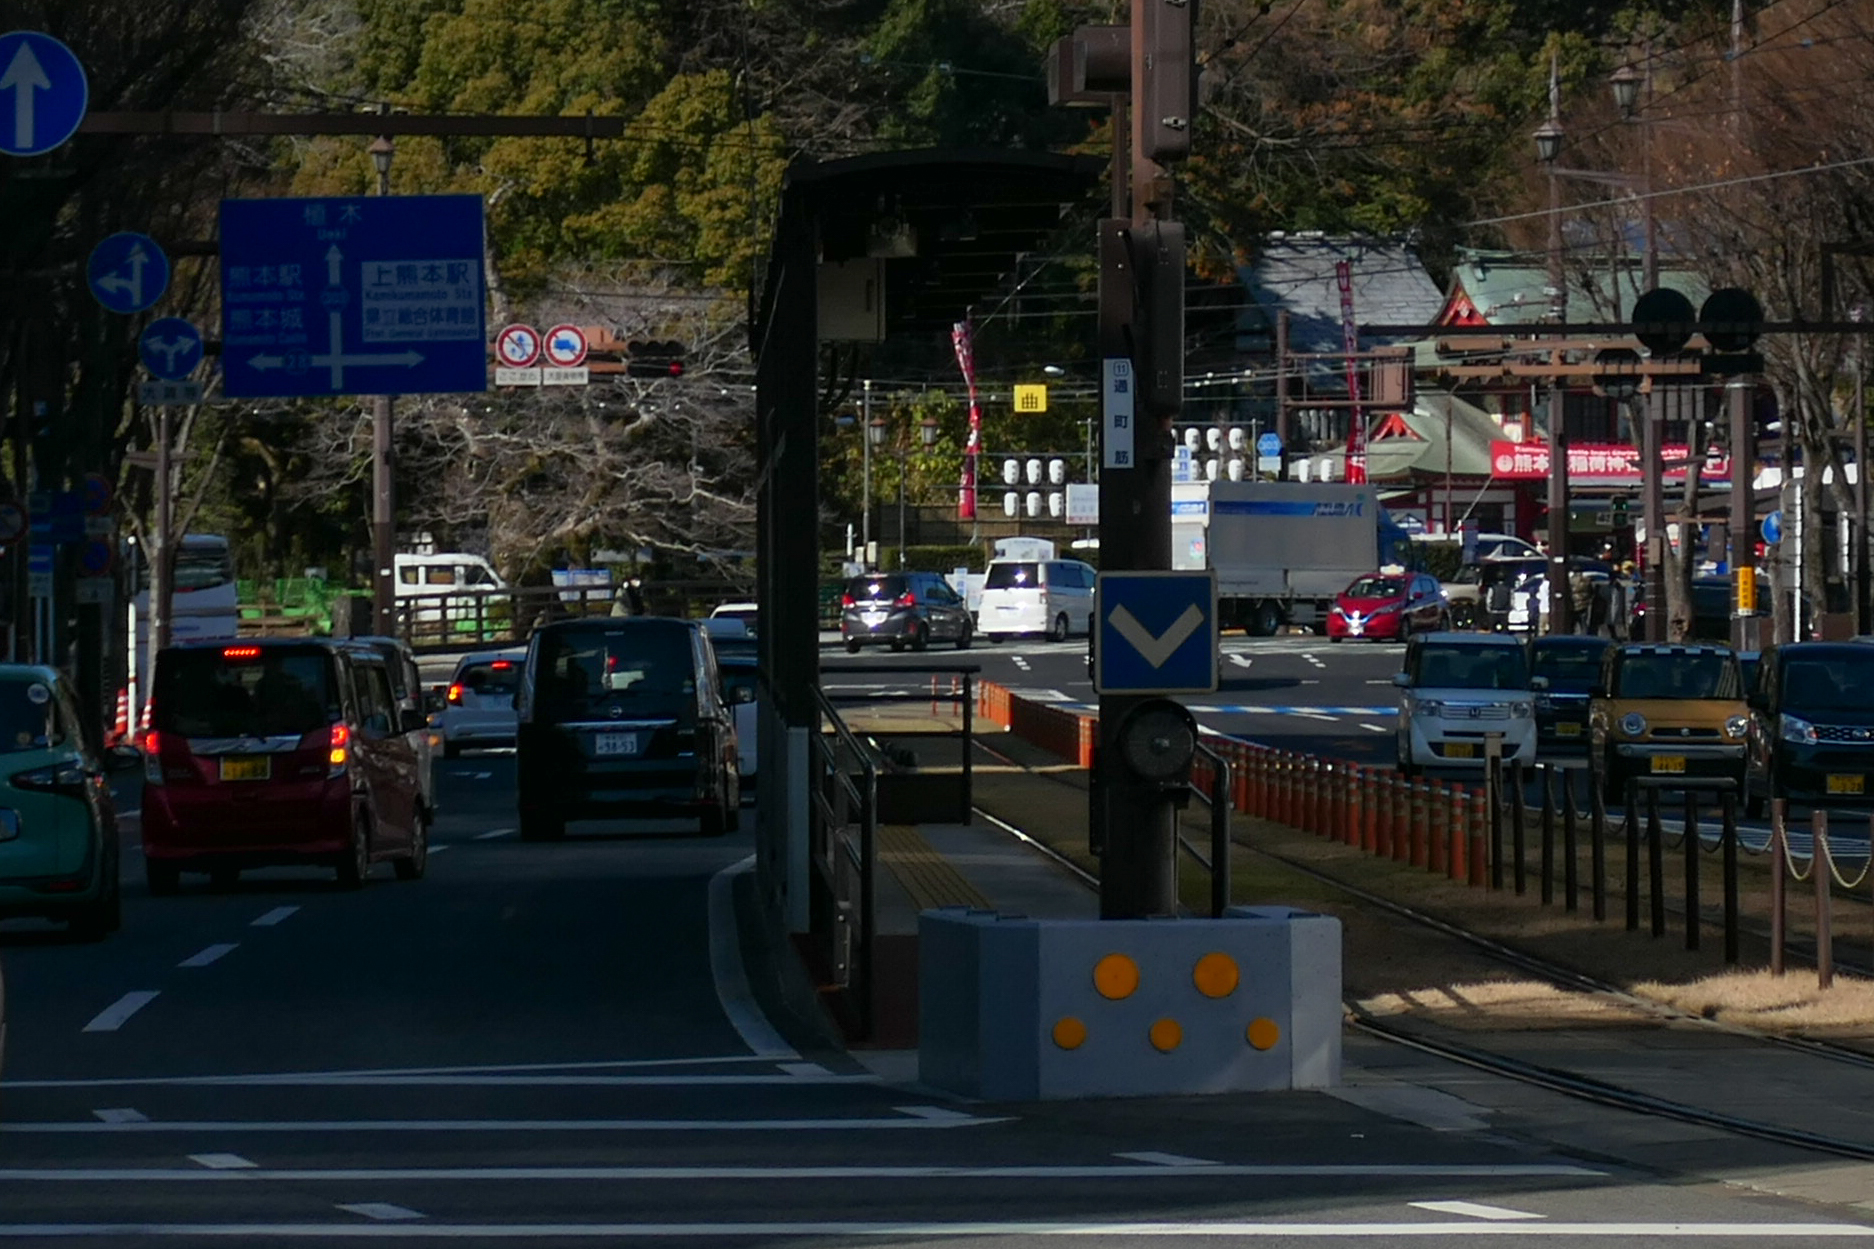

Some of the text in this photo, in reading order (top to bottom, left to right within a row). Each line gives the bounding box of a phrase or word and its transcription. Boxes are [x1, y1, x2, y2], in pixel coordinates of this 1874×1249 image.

[228, 264, 303, 288] 熊本駅
[371, 262, 470, 286] 上熊本駅
[229, 307, 304, 331] 熊本城
[1114, 379, 1129, 464] 通町筋
